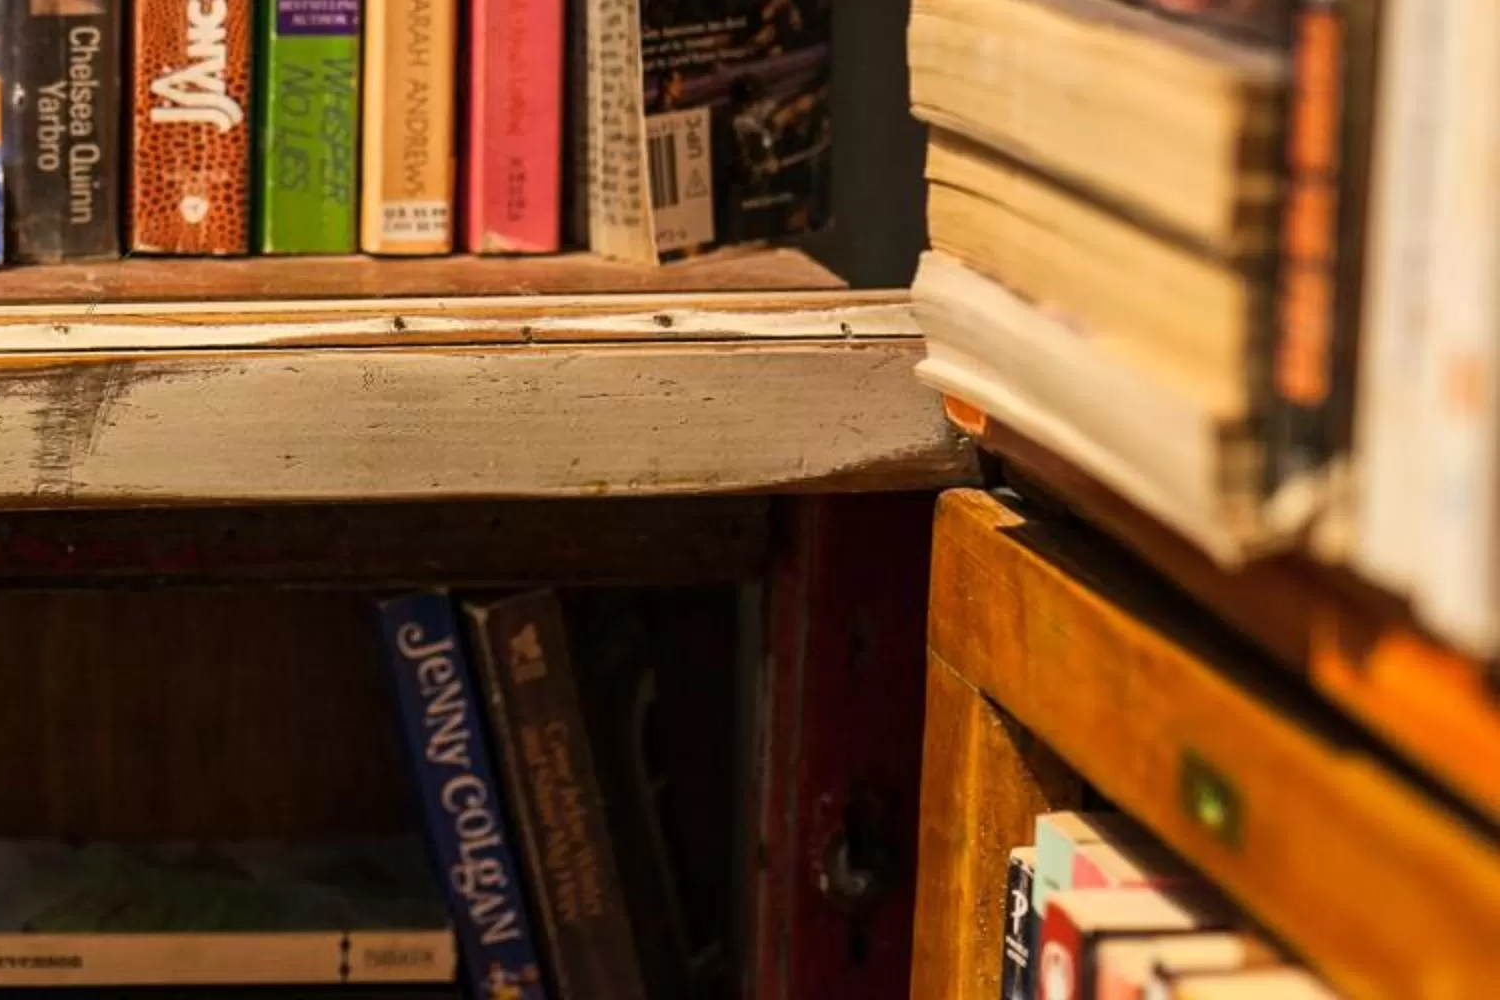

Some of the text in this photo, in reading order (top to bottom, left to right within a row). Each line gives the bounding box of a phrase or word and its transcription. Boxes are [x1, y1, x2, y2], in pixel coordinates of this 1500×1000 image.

[37, 81, 67, 174] Yarbro
[68, 25, 101, 225] Chelsea Quinn
[399, 80, 431, 199] ANDREWS
